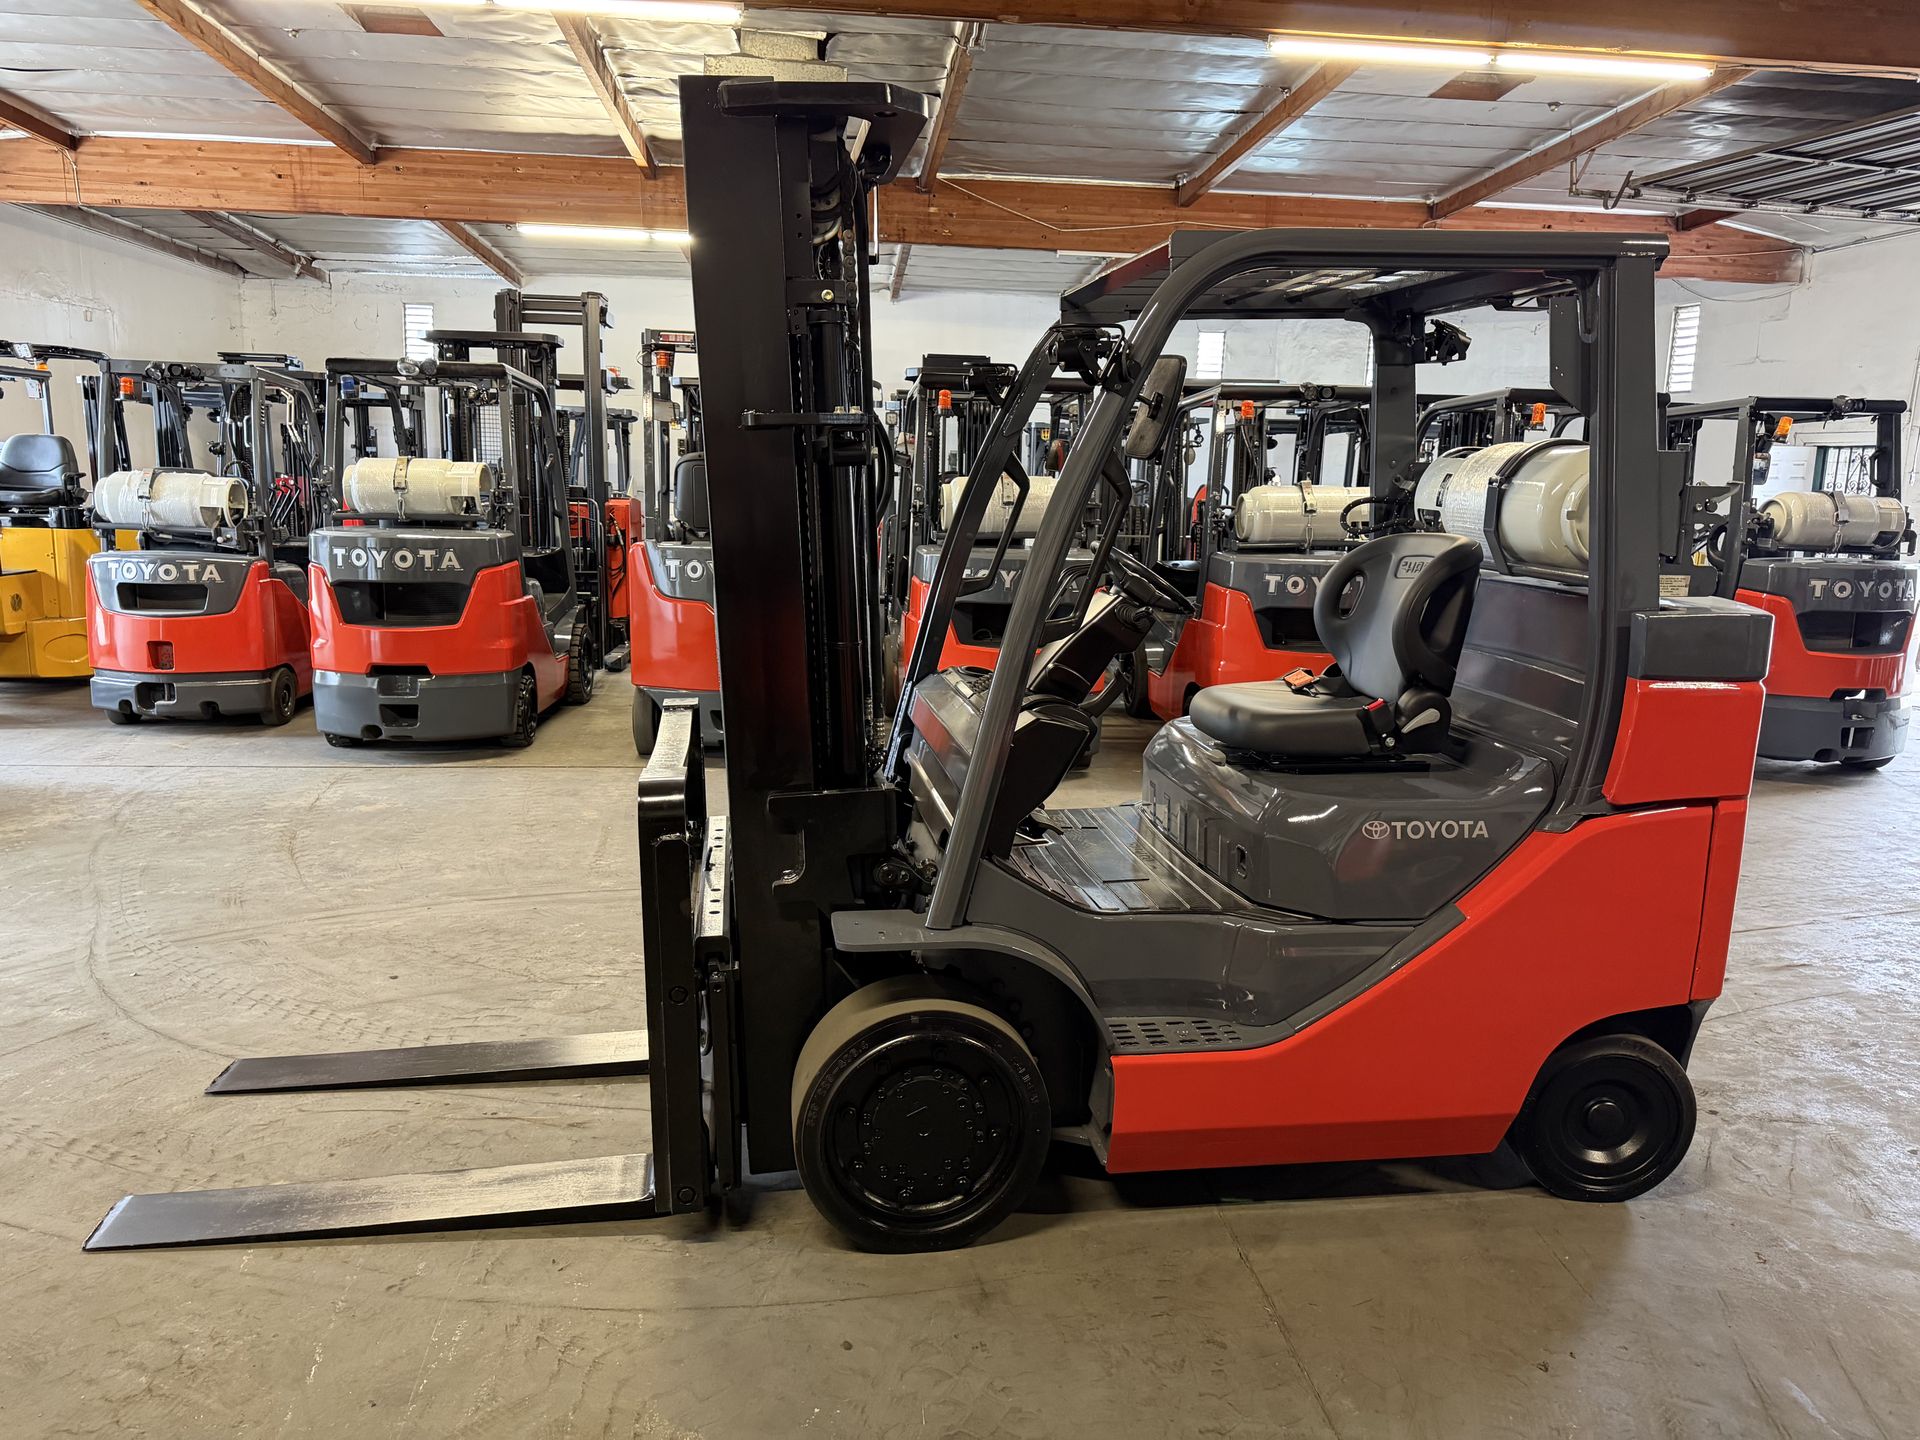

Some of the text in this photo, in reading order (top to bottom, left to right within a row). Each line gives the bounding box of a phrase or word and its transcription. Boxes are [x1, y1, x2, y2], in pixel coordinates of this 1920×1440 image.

[332, 547, 461, 570] TOYOTA
[107, 561, 222, 582] TOYOTA
[1810, 579, 1916, 600] TOYOTA
[1391, 820, 1489, 840] TOYOTA
